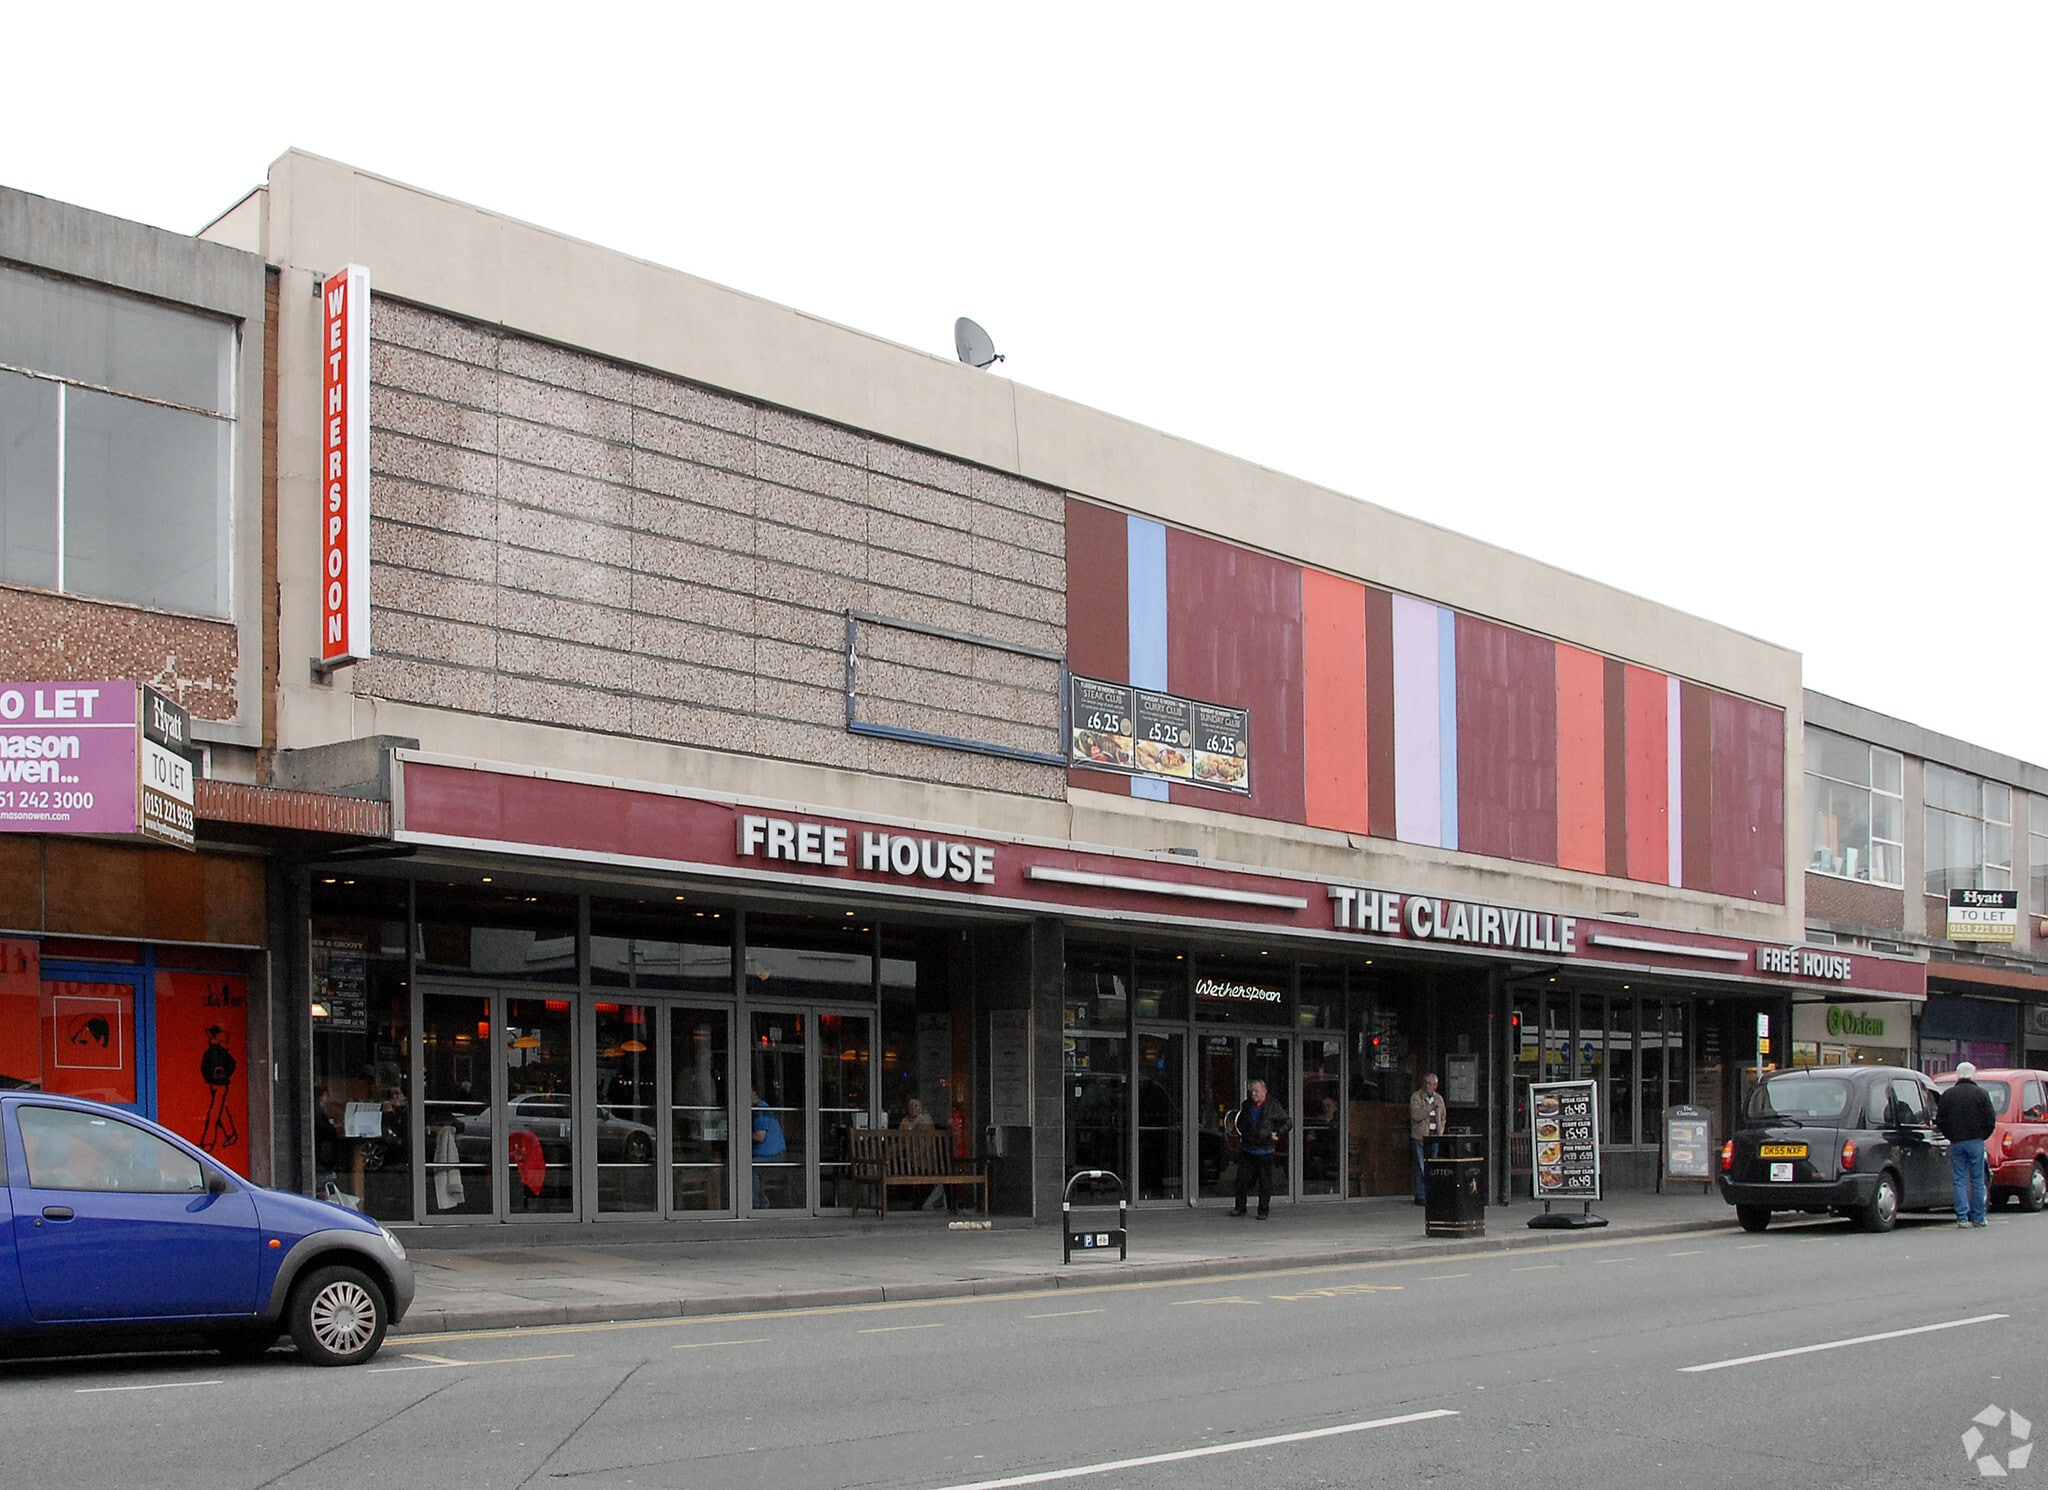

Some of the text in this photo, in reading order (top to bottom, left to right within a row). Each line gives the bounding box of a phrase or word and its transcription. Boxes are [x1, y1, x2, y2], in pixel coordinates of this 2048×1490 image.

[327, 284, 345, 644] WETHERSPOON
[0, 689, 99, 719] O LET
[1083, 689, 1105, 701] STEAK
[1105, 694, 1123, 704] CLUB
[1144, 701, 1165, 713] CURRY
[1165, 705, 1183, 716] CLUB
[153, 696, 183, 744] Hyatt
[1087, 712, 1119, 733] £6.25
[1224, 717, 1241, 728] CLUB
[1149, 723, 1179, 744] £5.25
[1206, 734, 1235, 755] £6.25
[152, 753, 185, 792] TO LET
[19, 791, 49, 809] 242
[53, 792, 94, 809] 3000
[144, 792, 194, 831] 0151 221 9333
[738, 814, 995, 885] FREE HOUSE
[1963, 891, 2004, 906] Hyatt
[1329, 886, 1576, 953] THE CLAIRVILLE
[1961, 910, 2006, 921] TO LET
[1758, 947, 1851, 980] FREE HOUSE
[1195, 979, 1281, 1002] Wetherspoon
[1843, 1010, 1885, 1036] Oxfam
[1564, 1103, 1587, 1115] £6.49
[1565, 1127, 1588, 1140] £5.49
[1568, 1175, 1591, 1187] £6.49
